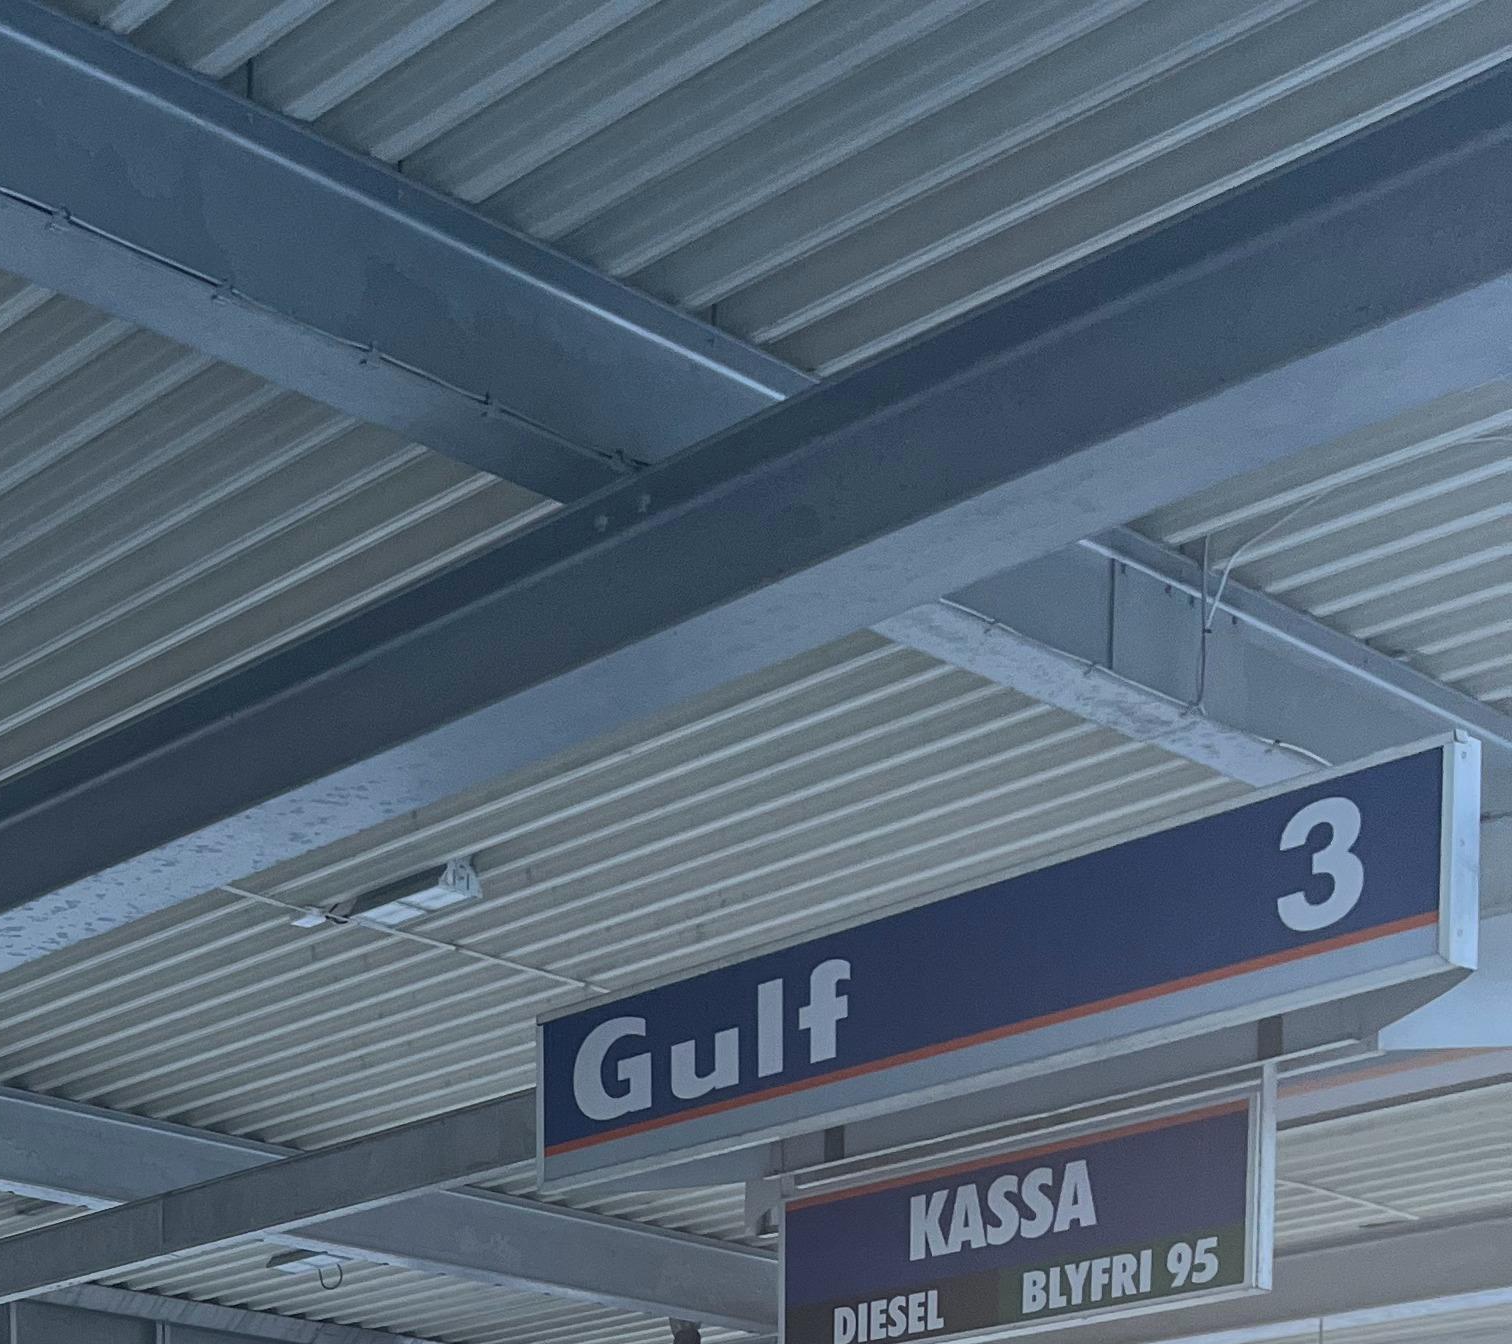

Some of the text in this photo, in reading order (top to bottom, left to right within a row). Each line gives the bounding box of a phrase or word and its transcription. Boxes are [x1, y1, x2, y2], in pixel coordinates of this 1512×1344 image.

[1277, 797, 1366, 932] 3
[572, 958, 852, 1122] Gulf
[909, 1159, 1098, 1262] KASSA
[1022, 1237, 1219, 1315] BLYFRI 95
